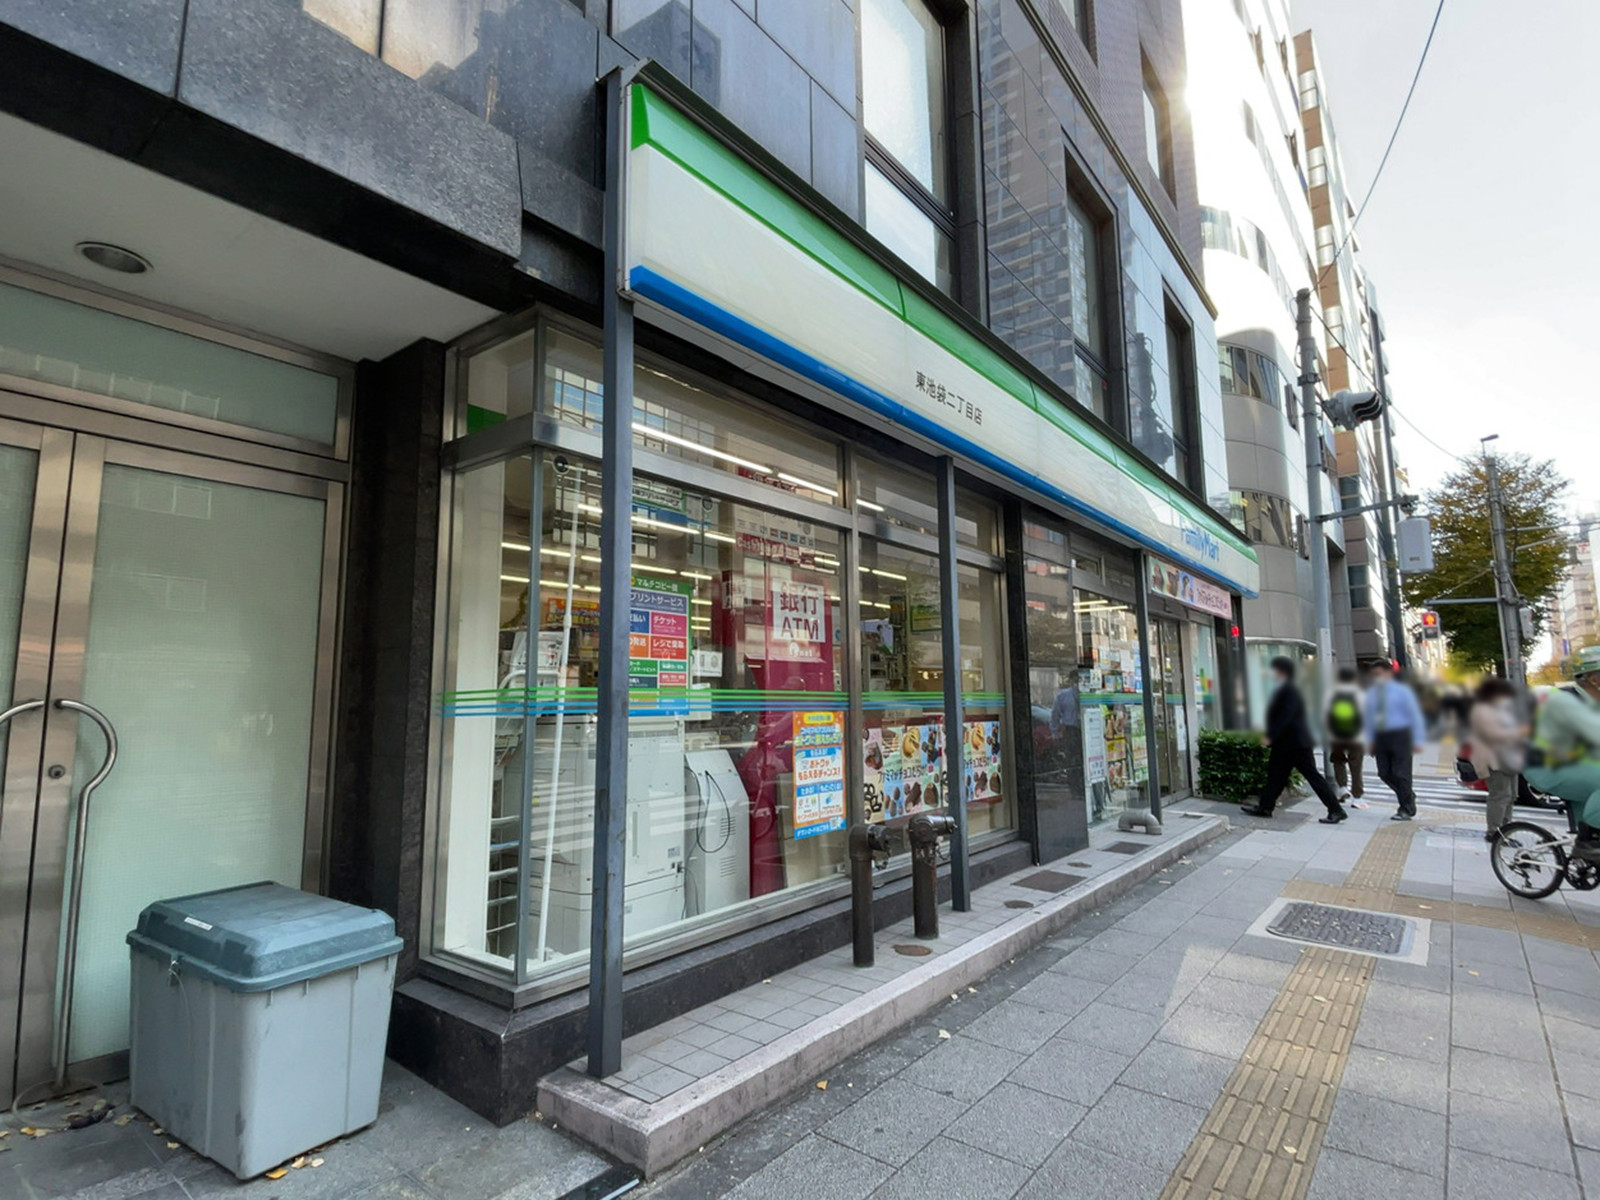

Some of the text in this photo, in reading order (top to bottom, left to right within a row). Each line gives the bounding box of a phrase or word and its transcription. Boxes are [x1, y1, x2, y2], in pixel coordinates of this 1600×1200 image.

[916, 371, 982, 425] 東池袋二丁目店
[637, 578, 678, 592] マルチコピー機
[780, 582, 819, 615] 銀行
[653, 616, 677, 625] チケット
[782, 616, 819, 640] ATM
